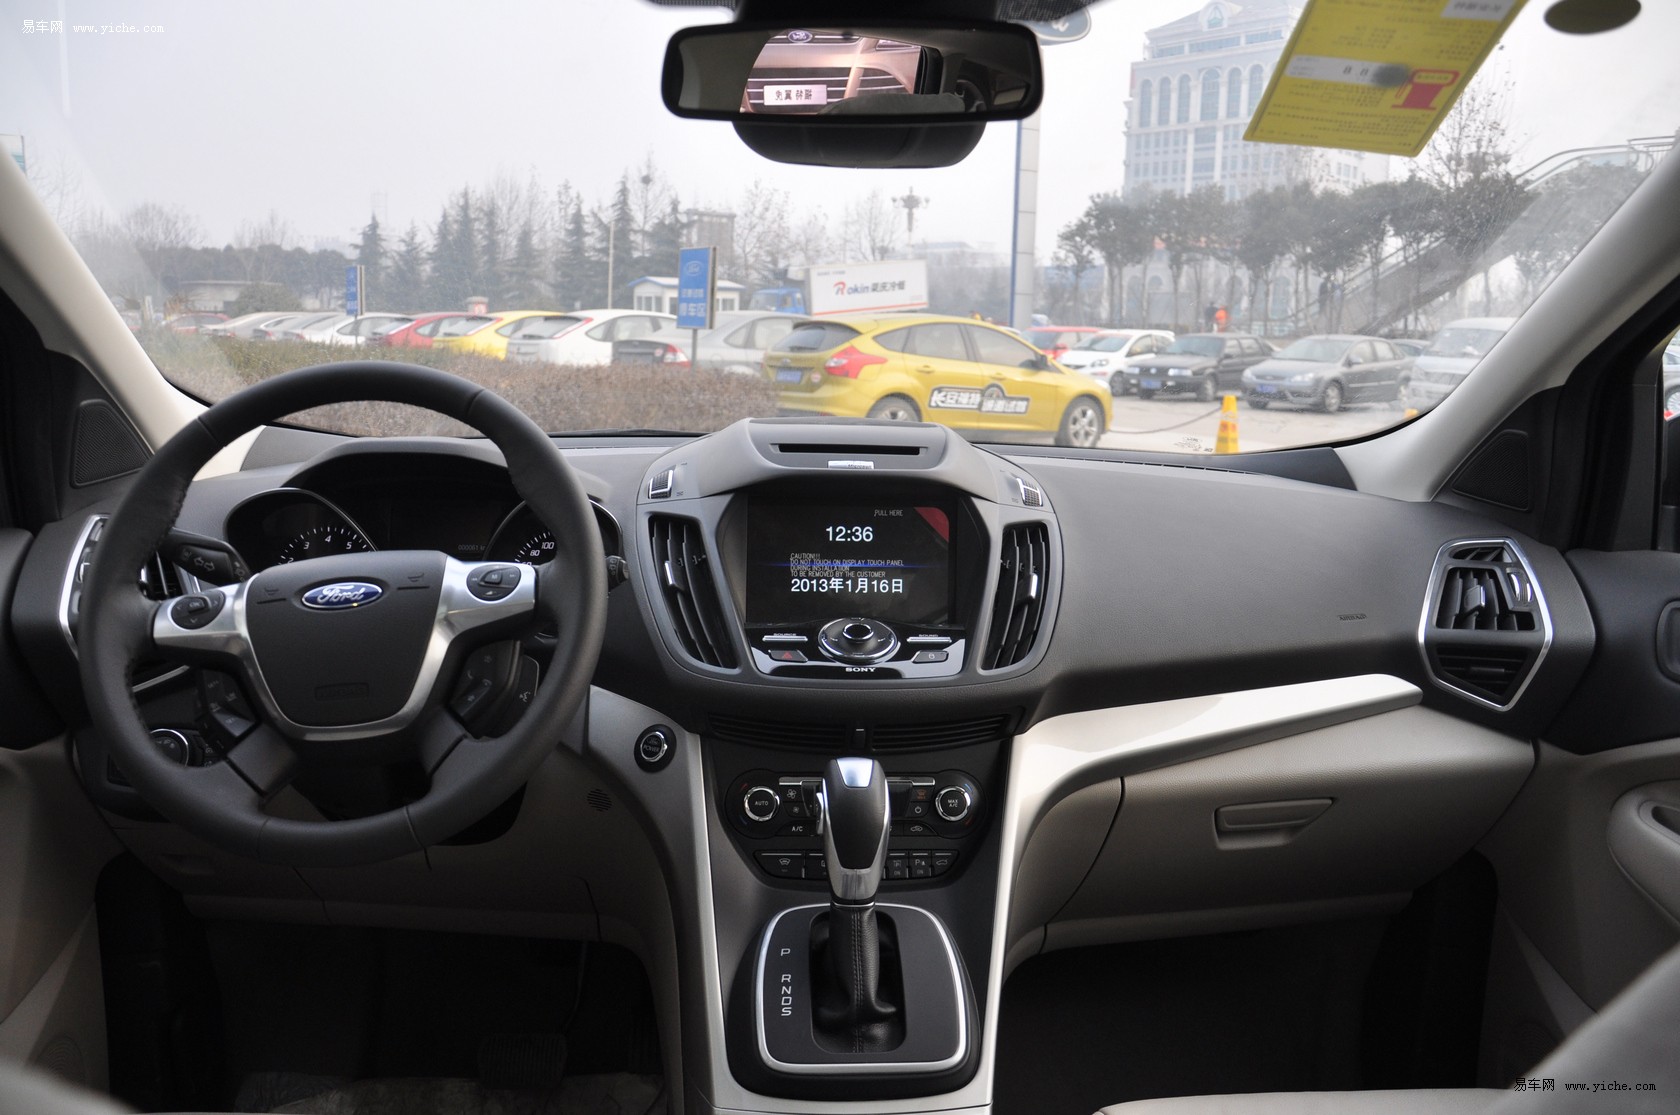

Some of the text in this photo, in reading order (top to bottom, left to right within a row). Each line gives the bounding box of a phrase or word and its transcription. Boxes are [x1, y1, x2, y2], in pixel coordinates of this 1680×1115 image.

[833, 281, 870, 296] Rokin
[888, 509, 904, 517] HERE
[825, 526, 874, 542] 12:36
[303, 541, 310, 549] 3
[346, 541, 352, 549] 5
[541, 541, 555, 550] 100
[529, 549, 541, 557] 80
[791, 577, 903, 593] 2013年1月16日
[780, 948, 791, 957] P
[781, 974, 792, 983] R
[781, 986, 792, 995] N
[781, 996, 792, 1006] D
[781, 1007, 792, 1016] S
